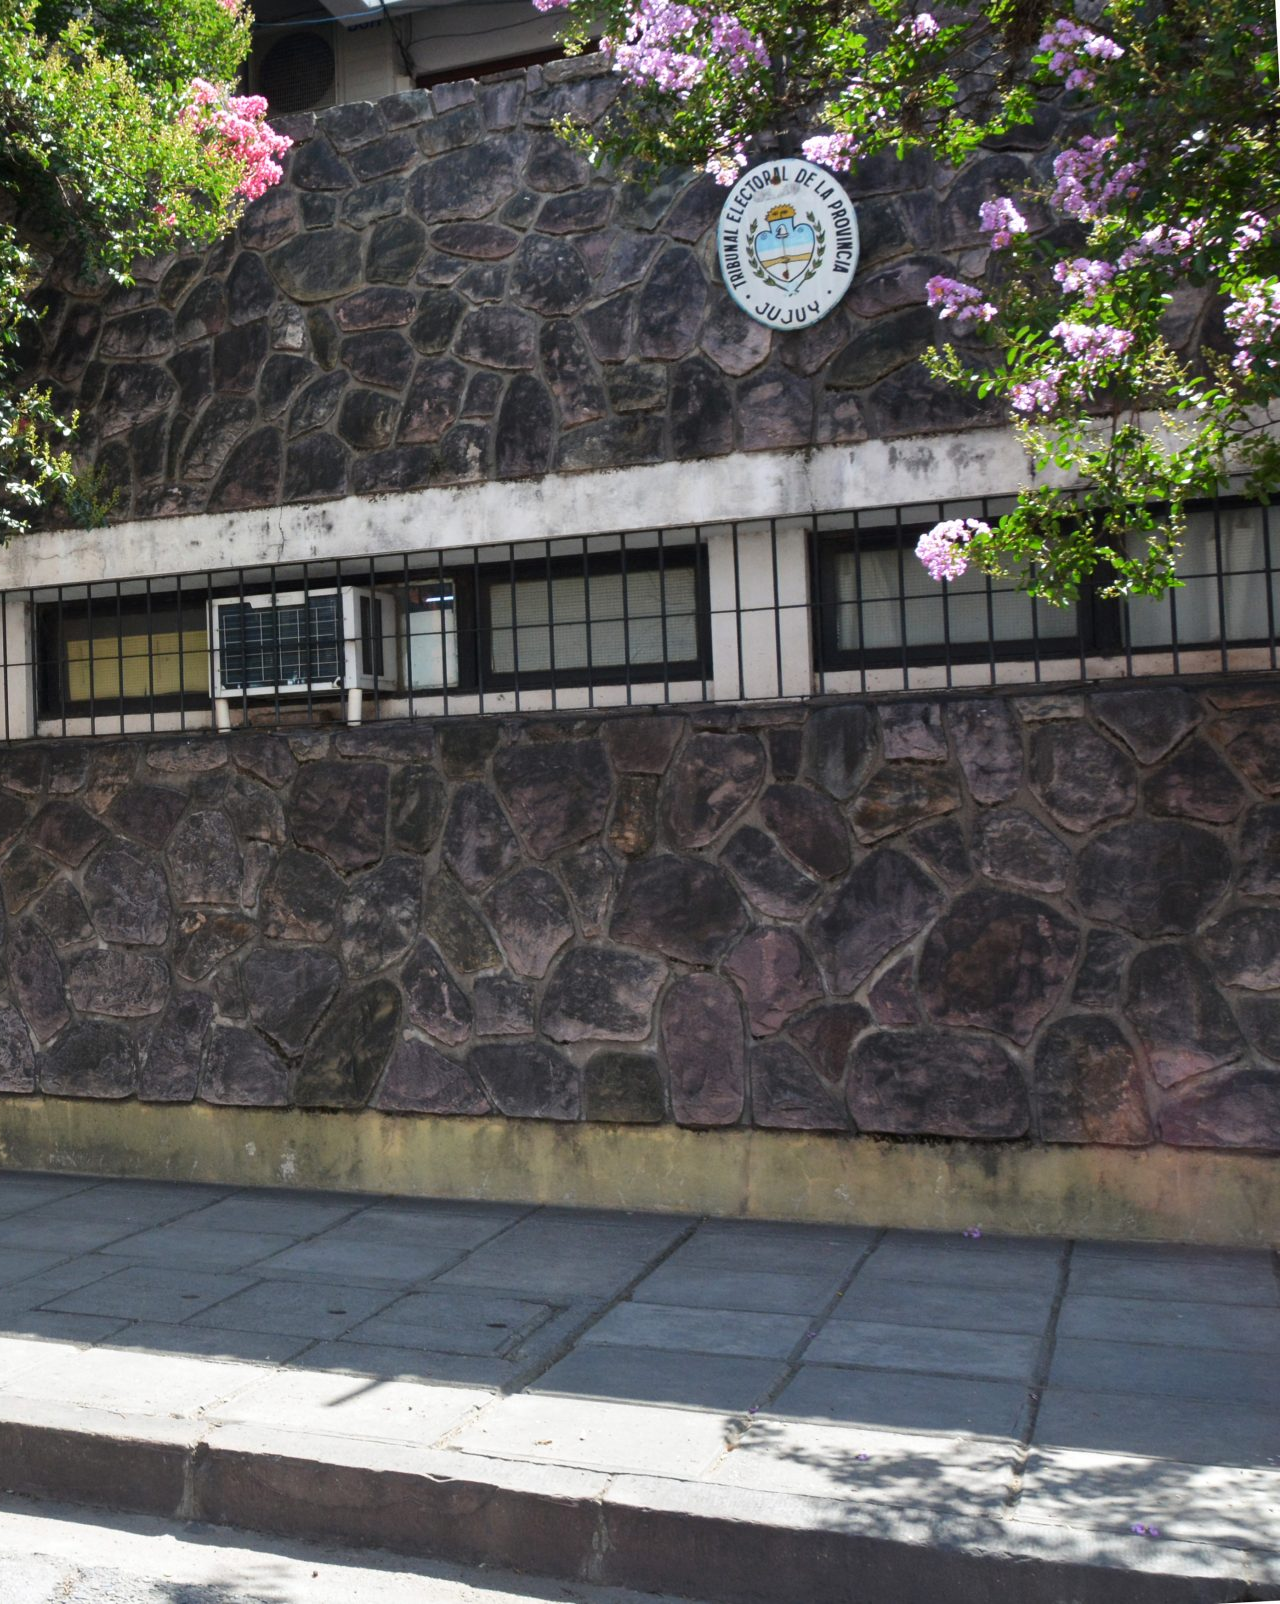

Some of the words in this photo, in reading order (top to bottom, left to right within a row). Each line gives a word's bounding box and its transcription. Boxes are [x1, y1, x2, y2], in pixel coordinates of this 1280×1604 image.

[726, 165, 789, 224] ELECTORAL
[794, 167, 818, 188] DE
[814, 179, 834, 201] LA
[827, 199, 854, 274] PROVINCIA
[723, 229, 746, 291] TRIBUNAL
[755, 300, 820, 325] JUJUY
